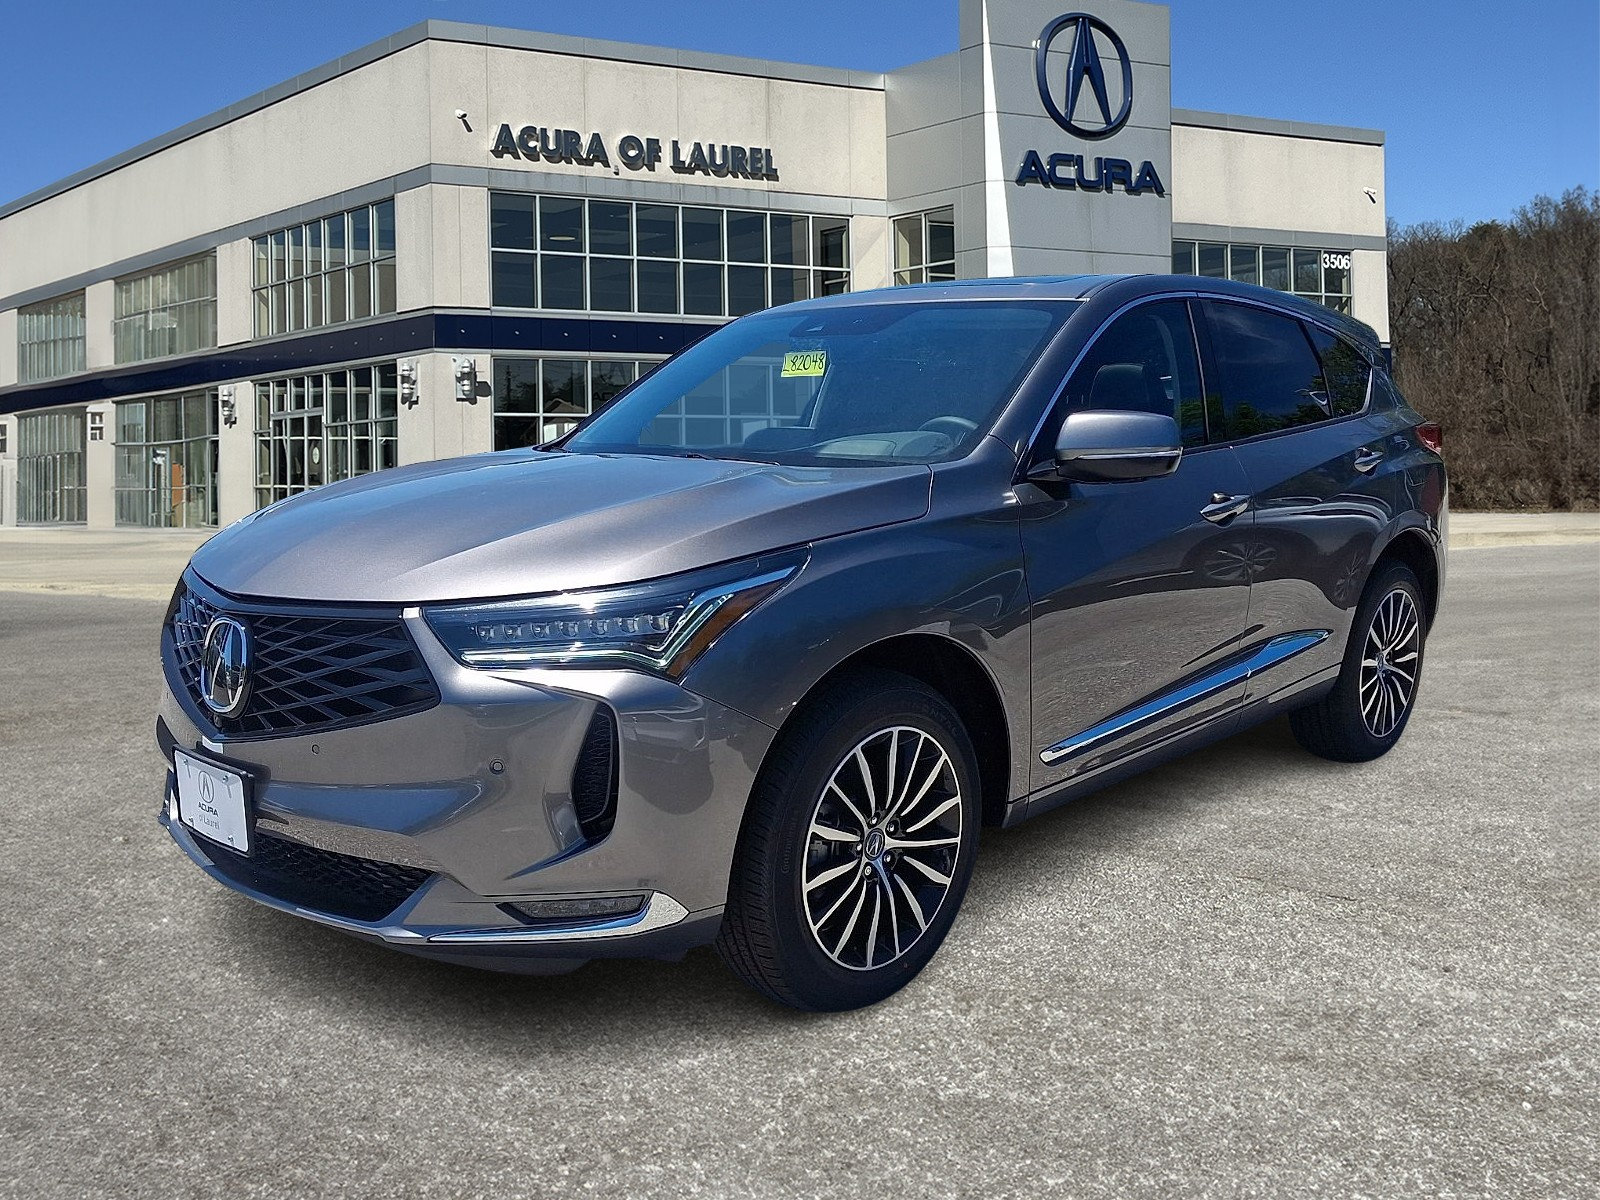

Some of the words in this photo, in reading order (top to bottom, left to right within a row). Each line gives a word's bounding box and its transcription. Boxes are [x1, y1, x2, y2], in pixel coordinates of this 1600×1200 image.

[492, 123, 611, 166] ACURA
[618, 135, 662, 170] OF
[671, 139, 779, 180] LAUREL
[1016, 149, 1165, 197] ACURA
[1322, 253, 1350, 270] 3506
[198, 802, 219, 817] ACURA
